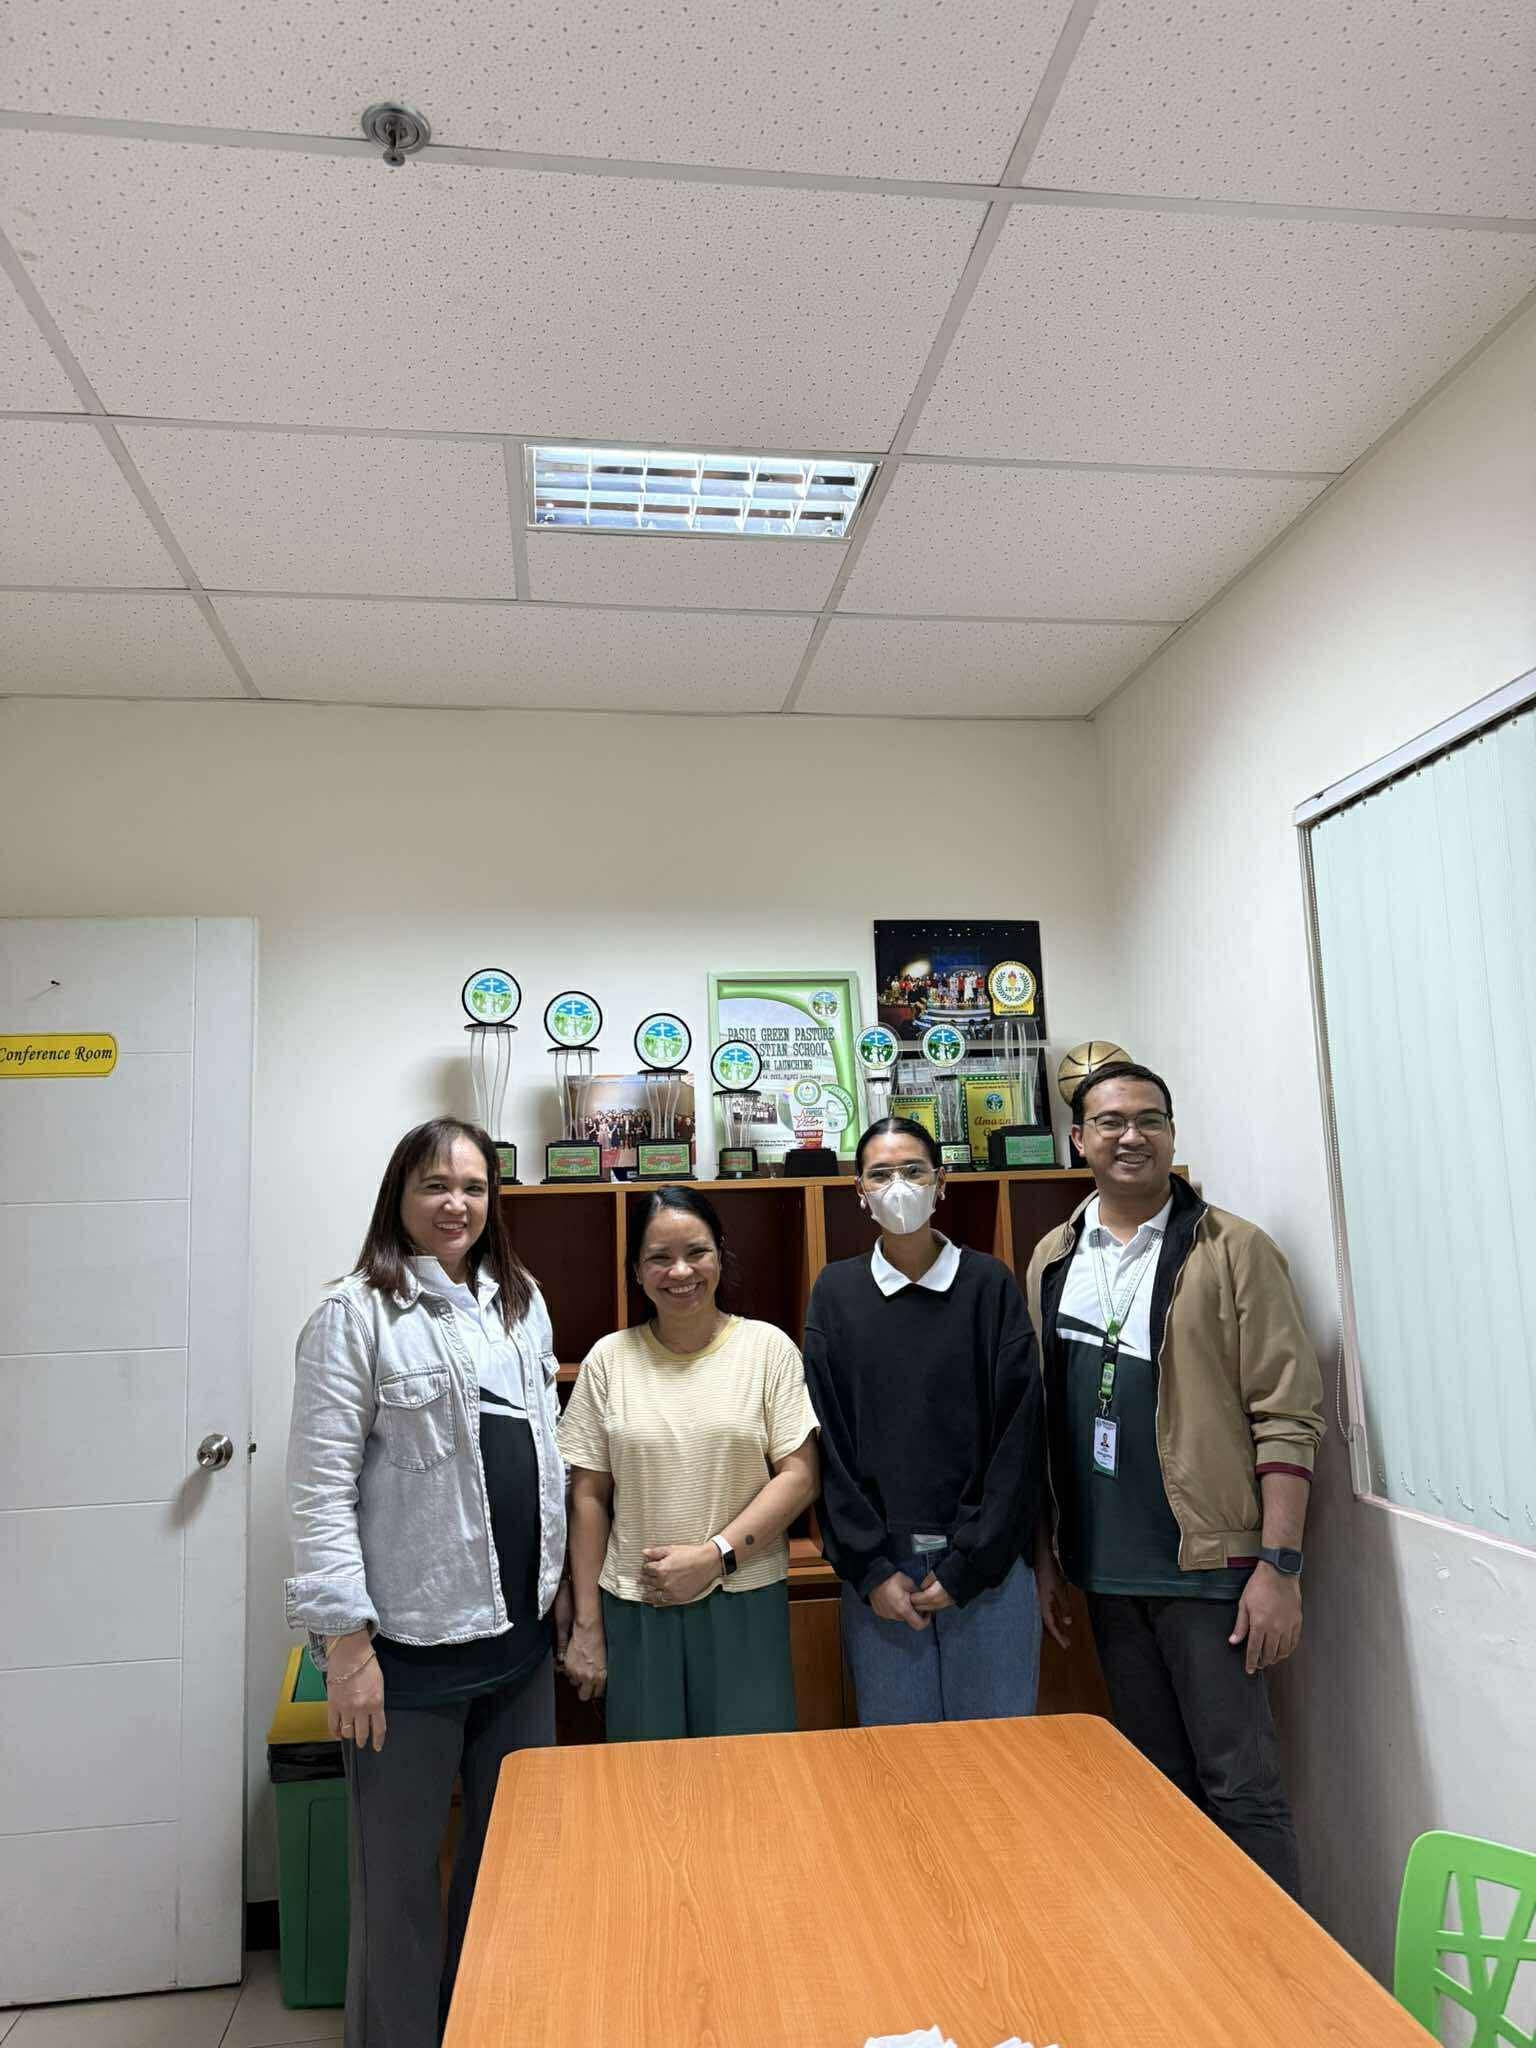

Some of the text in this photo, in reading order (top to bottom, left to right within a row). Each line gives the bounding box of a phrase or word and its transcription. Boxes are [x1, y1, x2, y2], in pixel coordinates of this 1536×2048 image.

[728, 1027, 835, 1041] PASIG GREEN PASTURE
[75, 1046, 113, 1062] Room
[756, 1043, 828, 1057] STIAN SCHOOL
[774, 1060, 813, 1070] LAUNCHING
